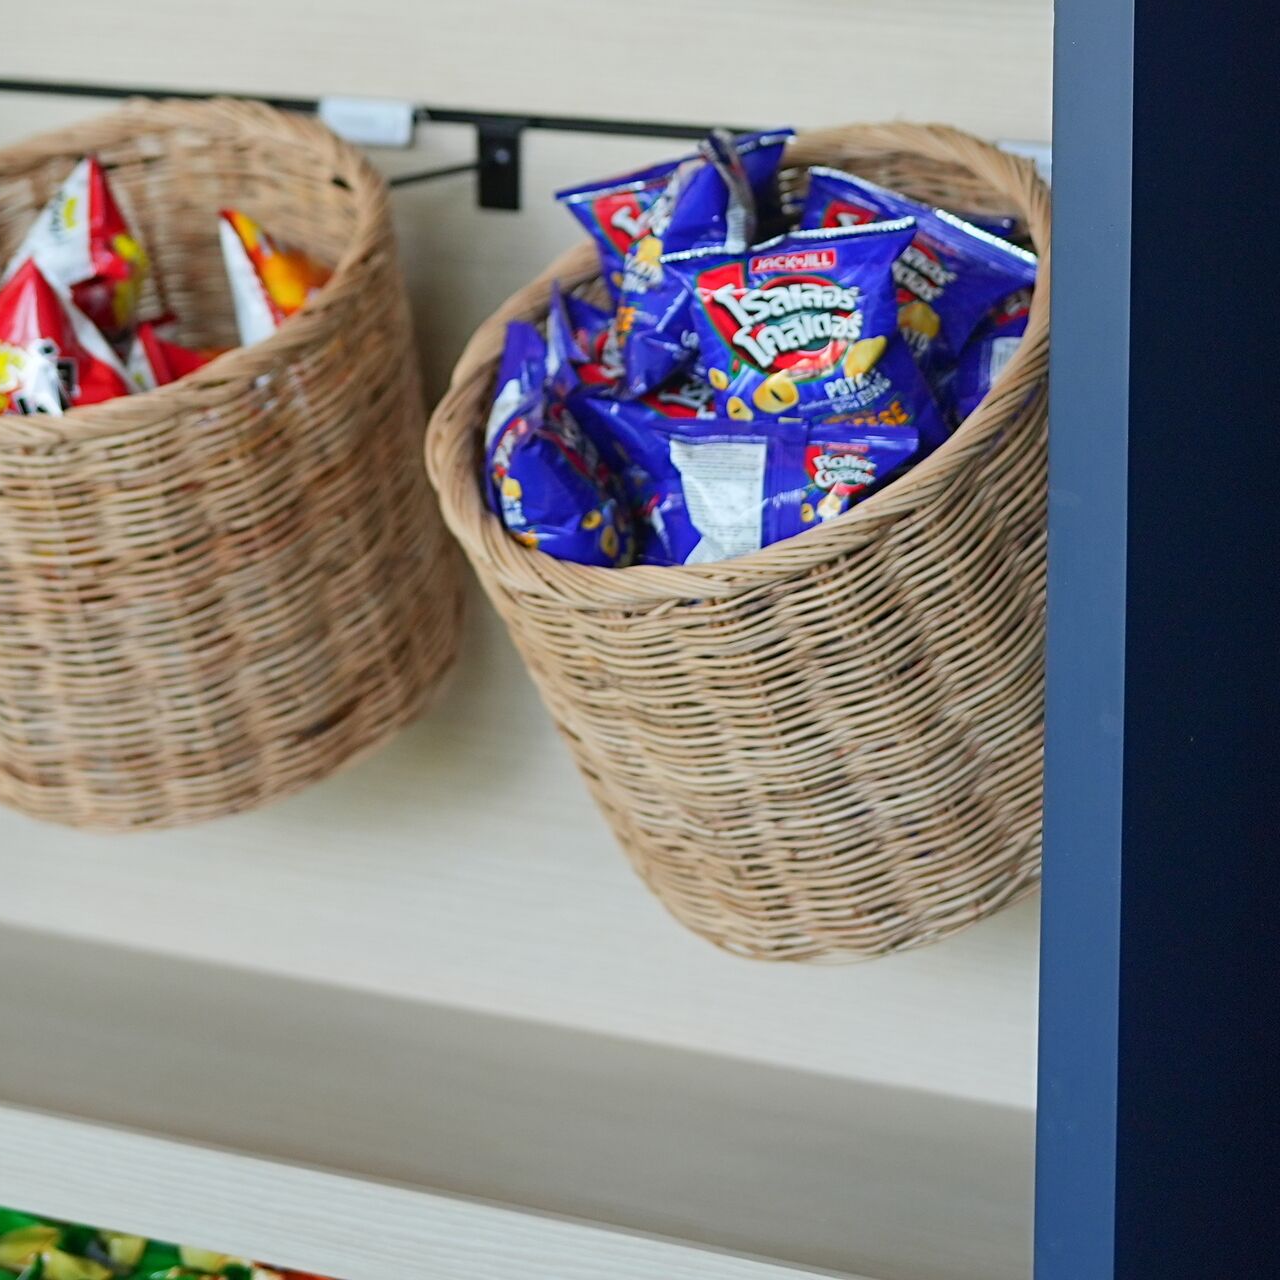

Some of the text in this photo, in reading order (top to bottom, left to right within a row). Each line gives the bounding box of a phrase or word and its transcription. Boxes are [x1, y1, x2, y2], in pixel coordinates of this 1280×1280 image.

[732, 310, 863, 368] โคสเตอร์
[813, 454, 877, 471] Roller
[814, 468, 877, 489] Coaster
